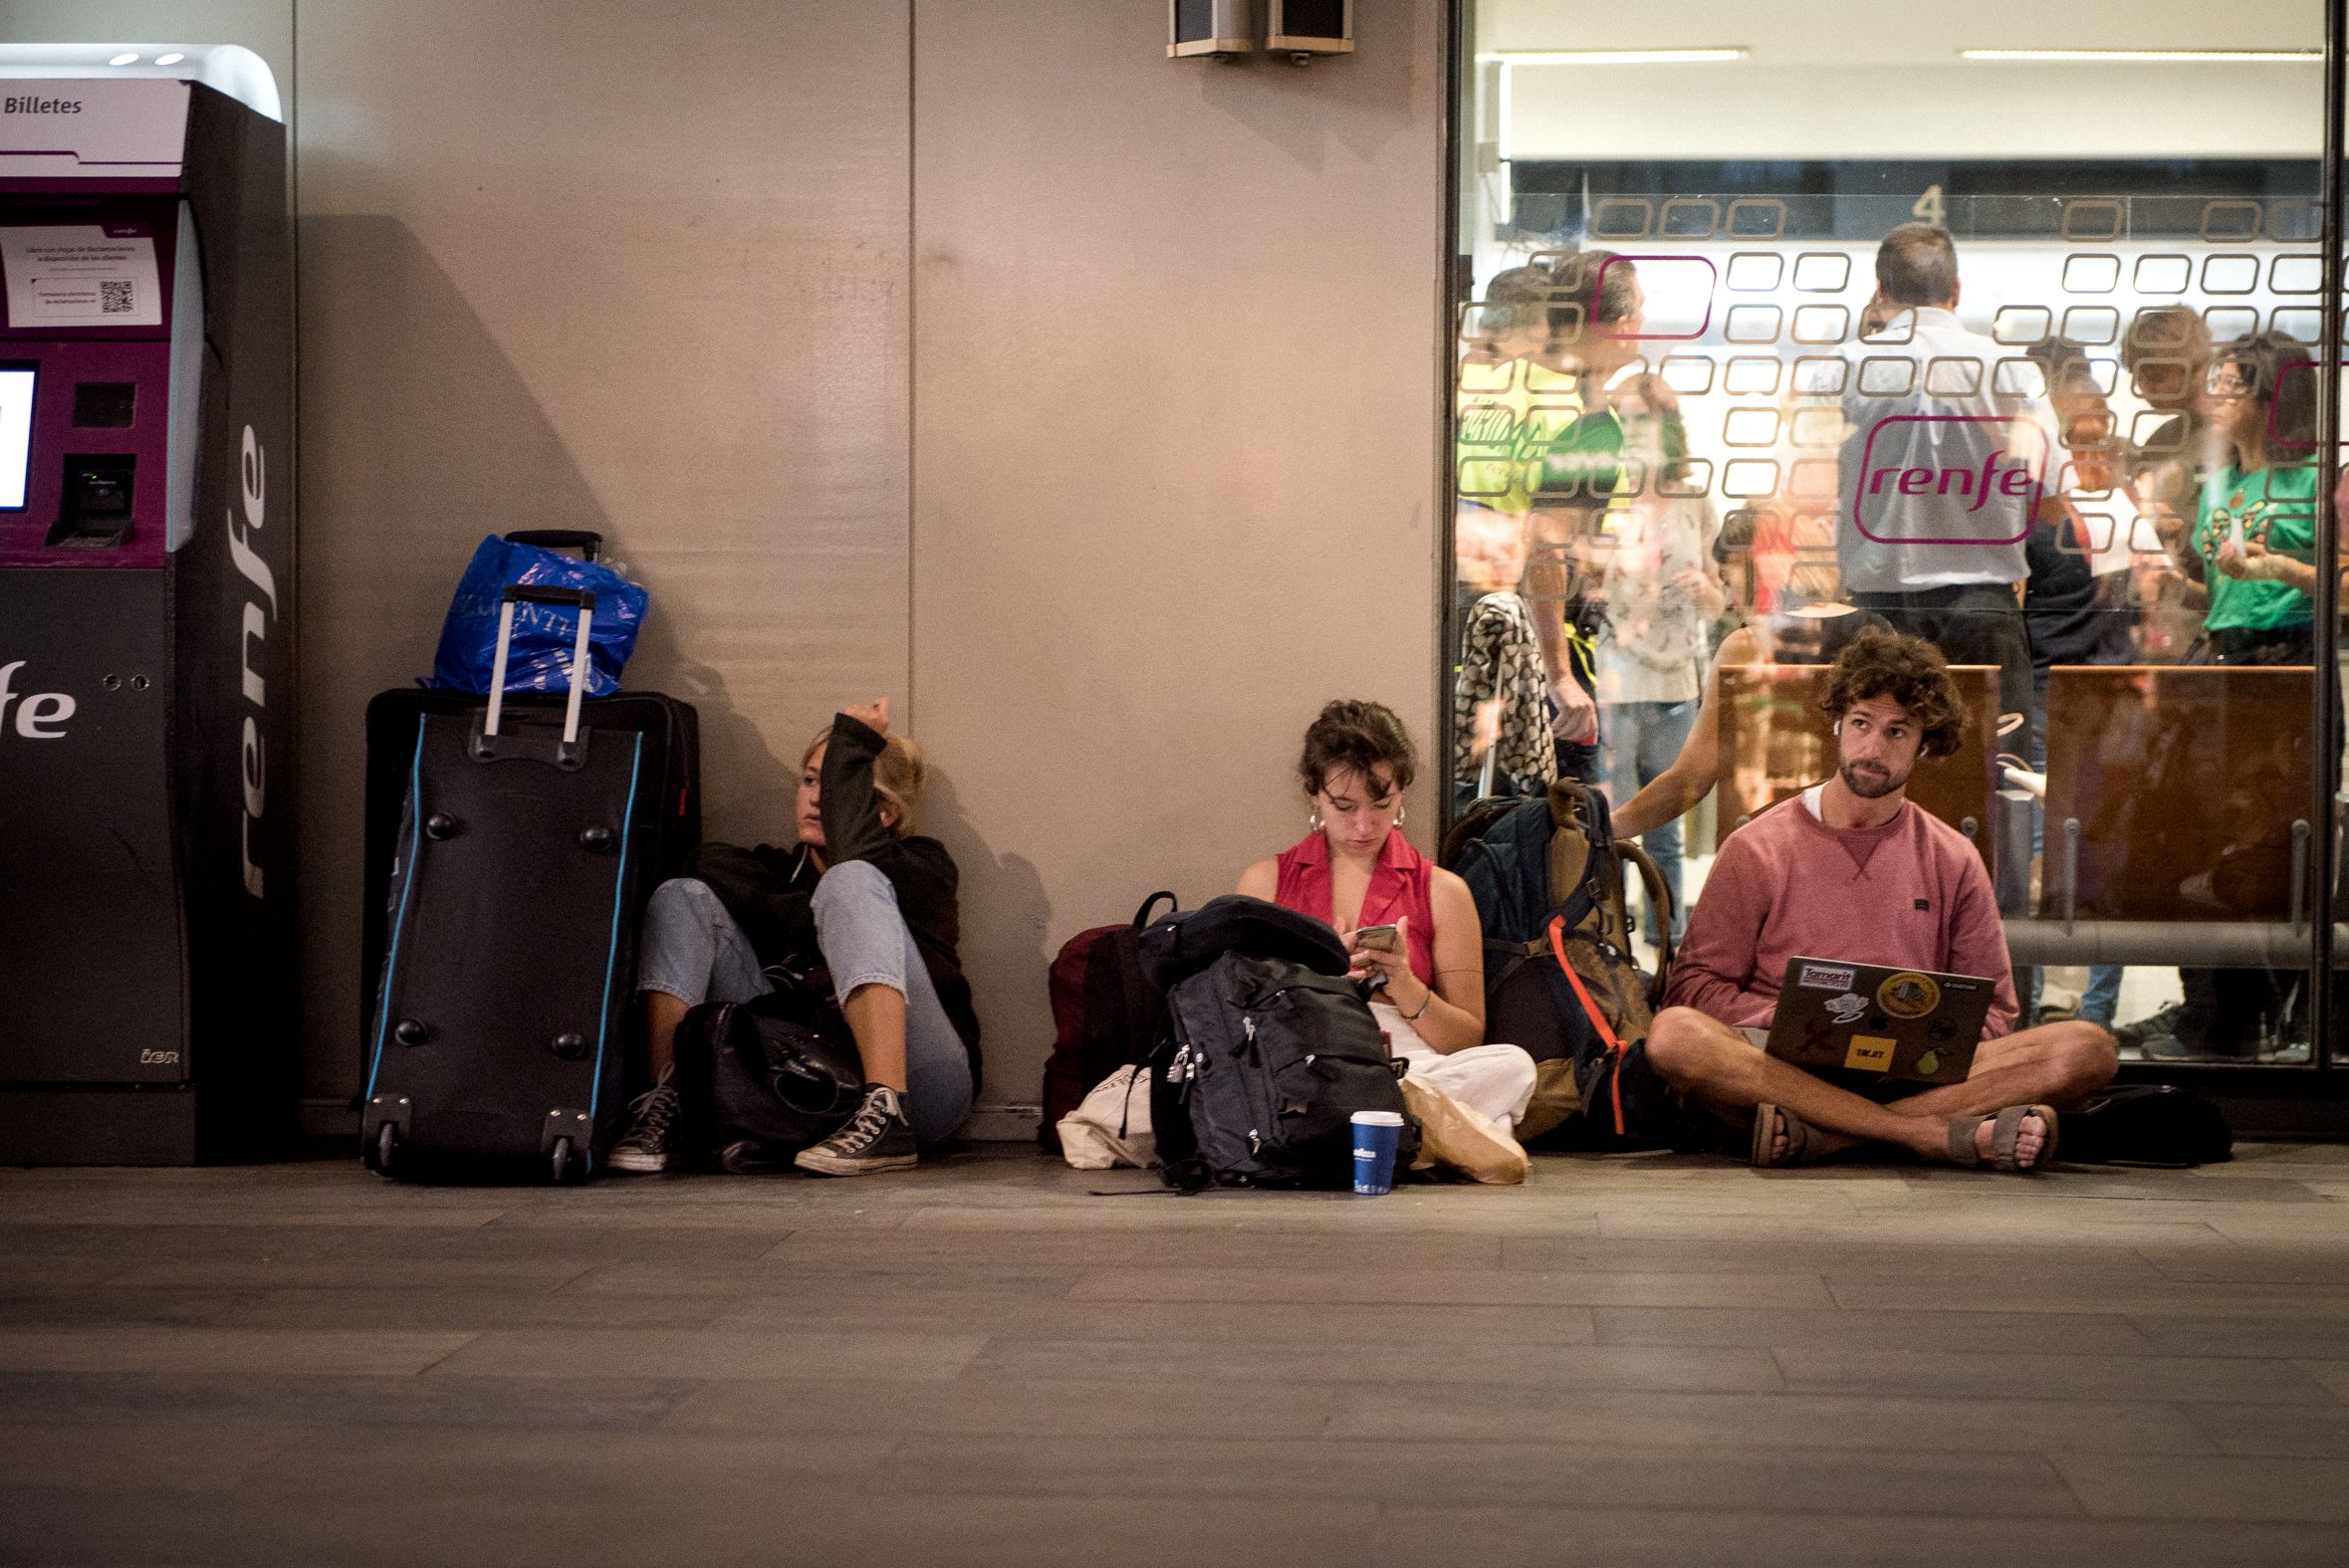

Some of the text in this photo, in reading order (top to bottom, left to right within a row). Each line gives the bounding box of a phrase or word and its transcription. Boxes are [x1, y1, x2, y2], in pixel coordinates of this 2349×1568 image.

[4, 97, 83, 113] Billetes
[1913, 184, 1944, 224] 4
[1868, 450, 2034, 512] renfe
[227, 424, 278, 900] renfe
